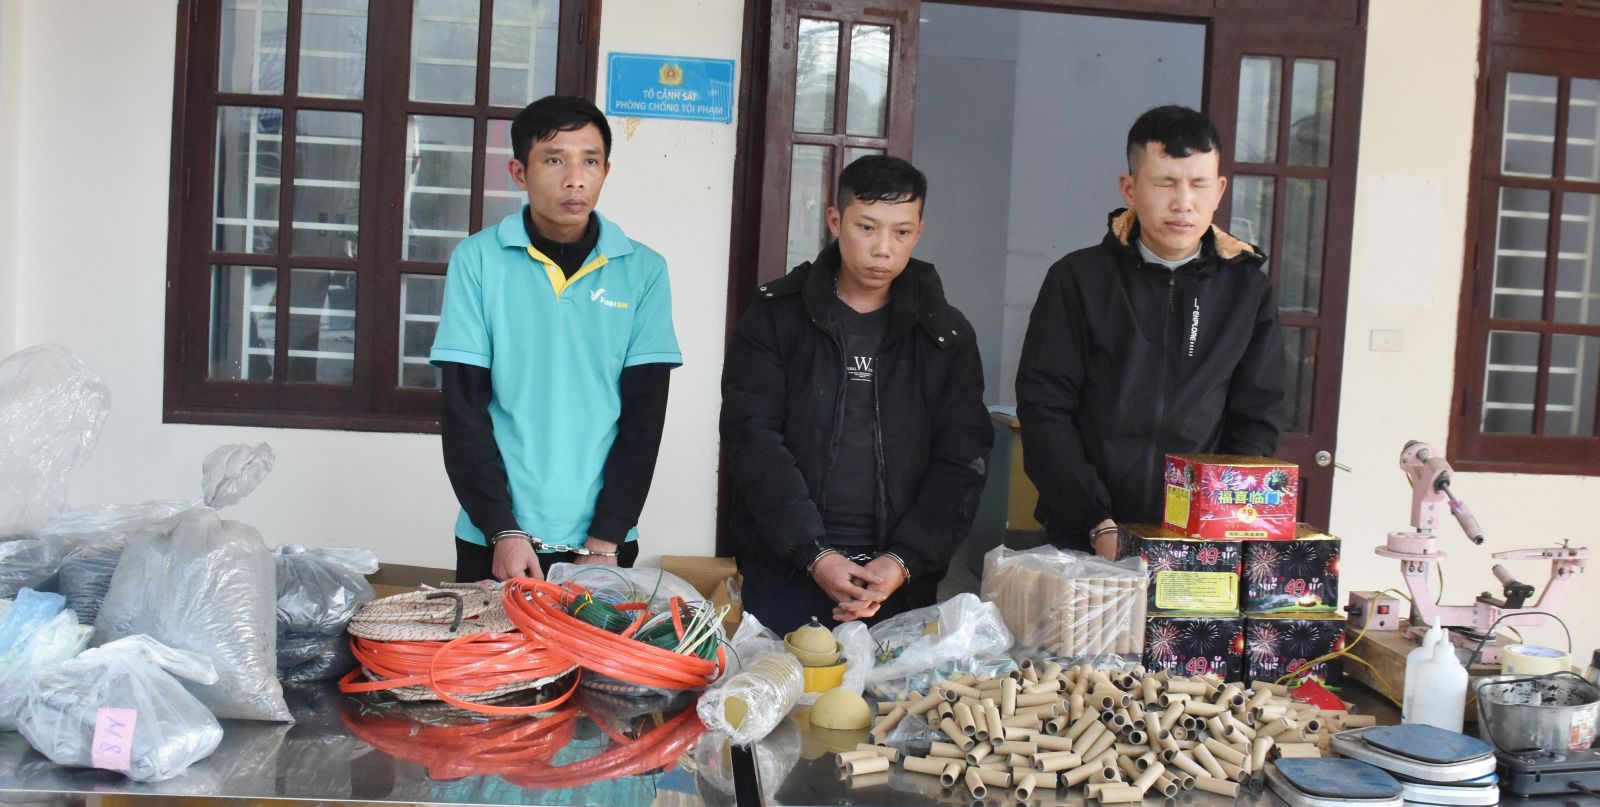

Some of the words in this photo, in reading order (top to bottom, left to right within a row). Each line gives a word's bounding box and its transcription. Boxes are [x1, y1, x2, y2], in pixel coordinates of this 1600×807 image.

[643, 88, 654, 99] TỔ
[656, 89, 681, 100] CẢNH
[682, 90, 697, 101] SÁT
[616, 99, 646, 110] PHÒNG
[648, 100, 679, 112] CHỐNG
[682, 103, 695, 114] TỘI
[697, 105, 723, 115] PHẠM
[1218, 490, 1281, 505] 福喜临门
[1196, 547, 1219, 565] 49
[1284, 578, 1306, 598] 49
[1185, 656, 1208, 675] 49
